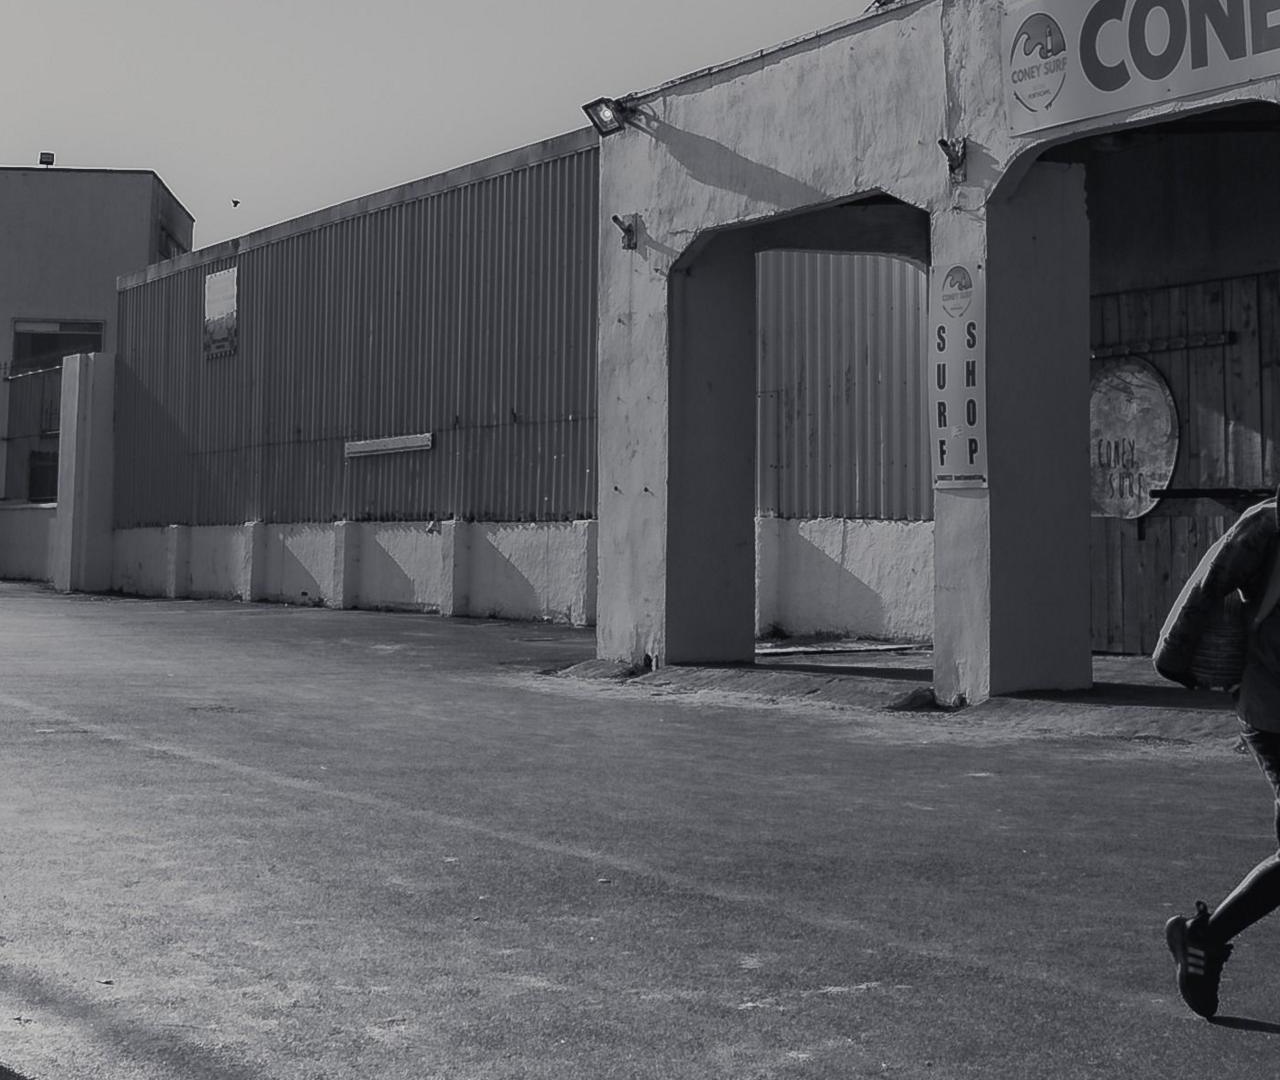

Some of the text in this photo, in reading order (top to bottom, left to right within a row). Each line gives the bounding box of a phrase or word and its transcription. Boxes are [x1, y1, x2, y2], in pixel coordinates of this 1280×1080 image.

[1011, 56, 1068, 85] CONEY SURF
[936, 324, 948, 467] SURF
[965, 321, 979, 465] SHOP
[1097, 437, 1136, 470] CONEY
